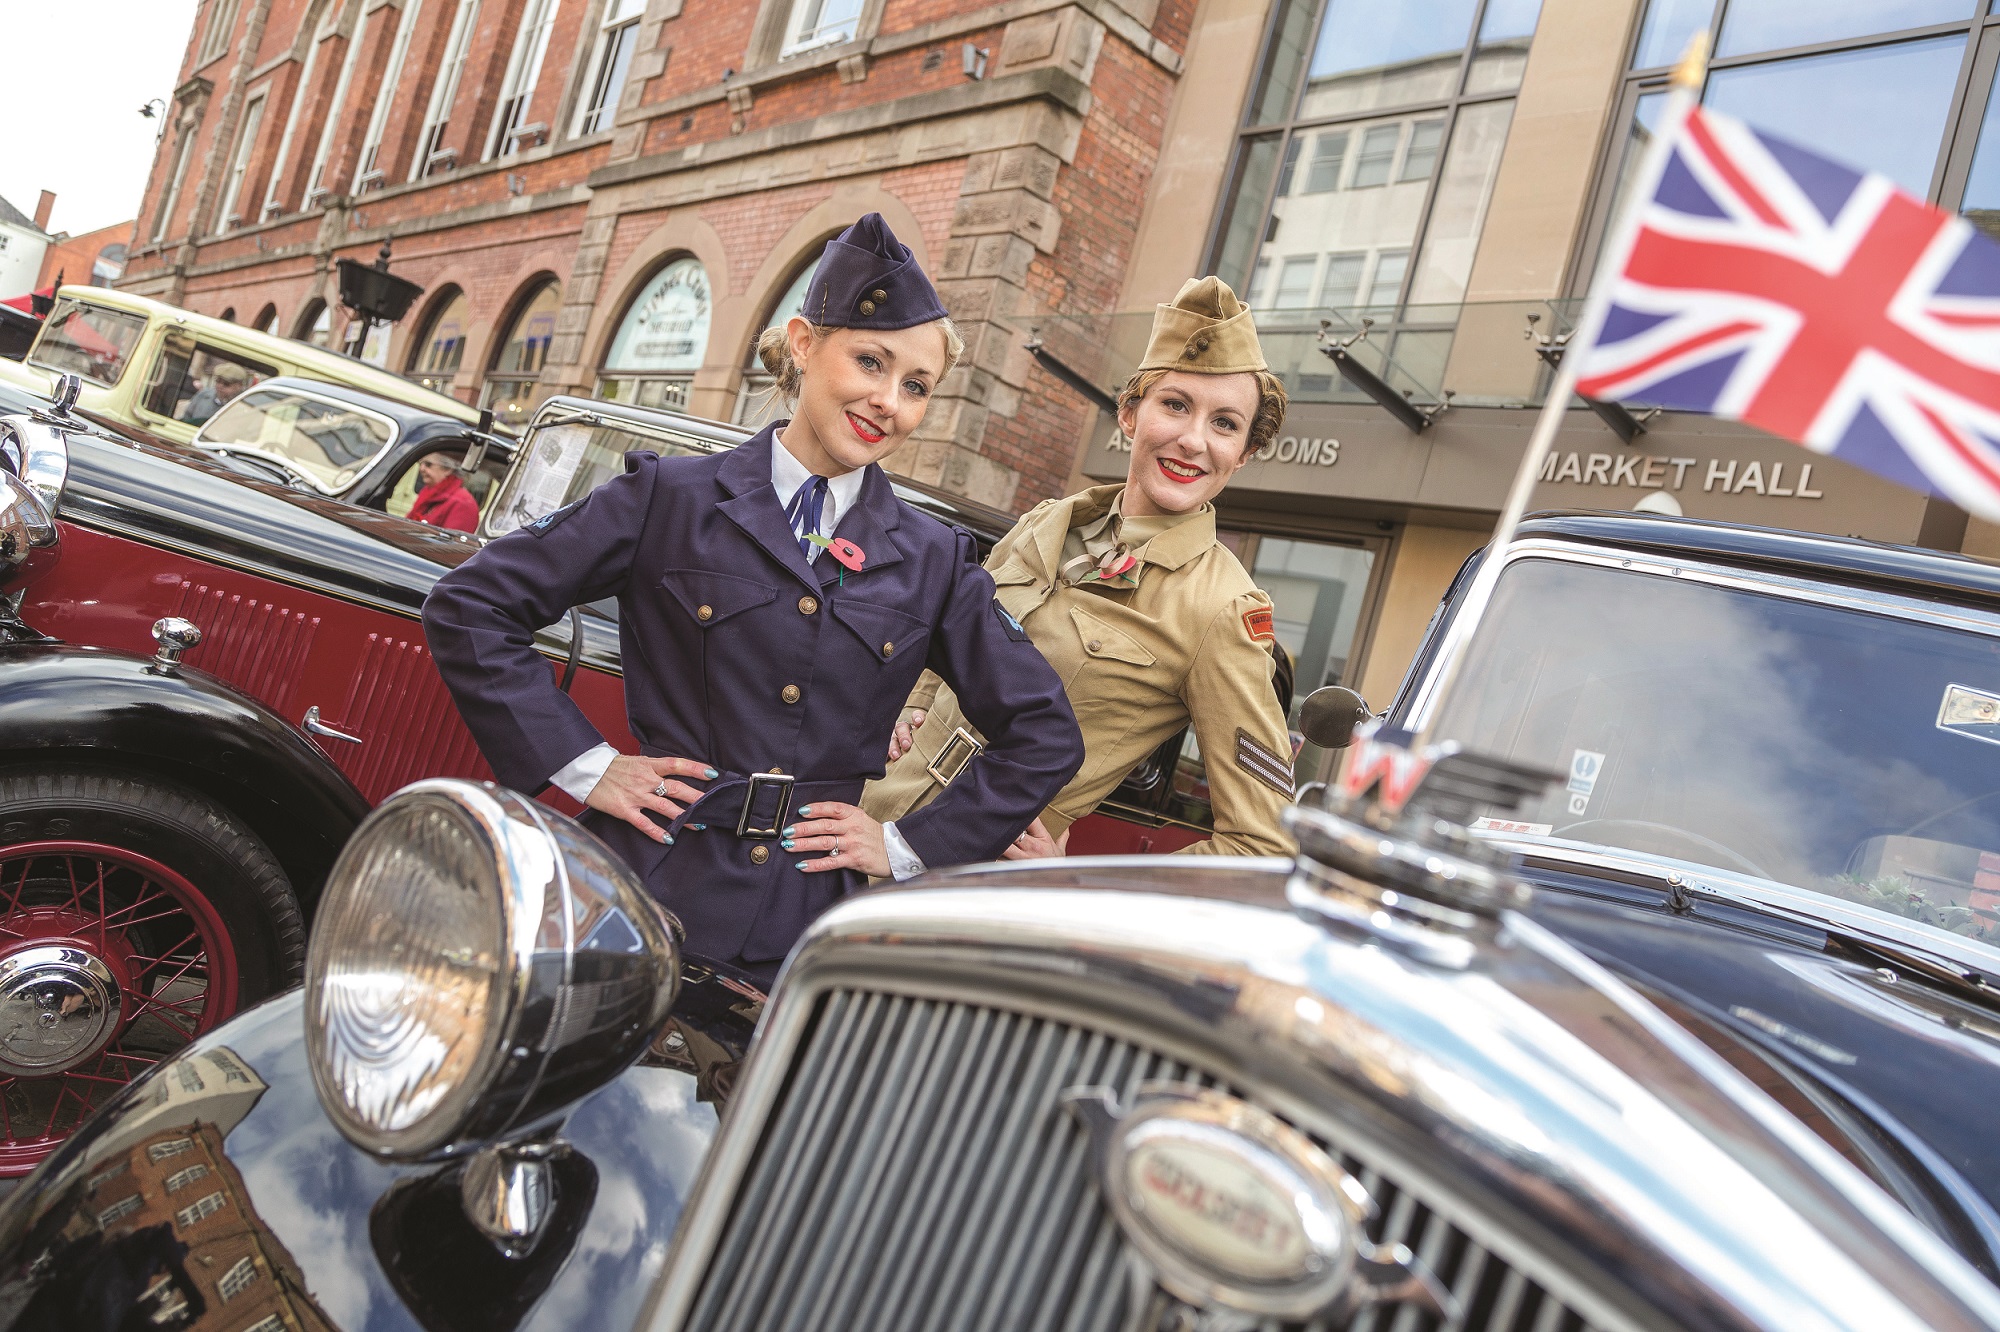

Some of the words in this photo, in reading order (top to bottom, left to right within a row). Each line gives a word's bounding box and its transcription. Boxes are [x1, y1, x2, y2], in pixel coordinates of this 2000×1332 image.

[1250, 436, 1340, 467] OOMS
[1537, 450, 1697, 491] MARKET
[1703, 458, 1824, 499] HALL
